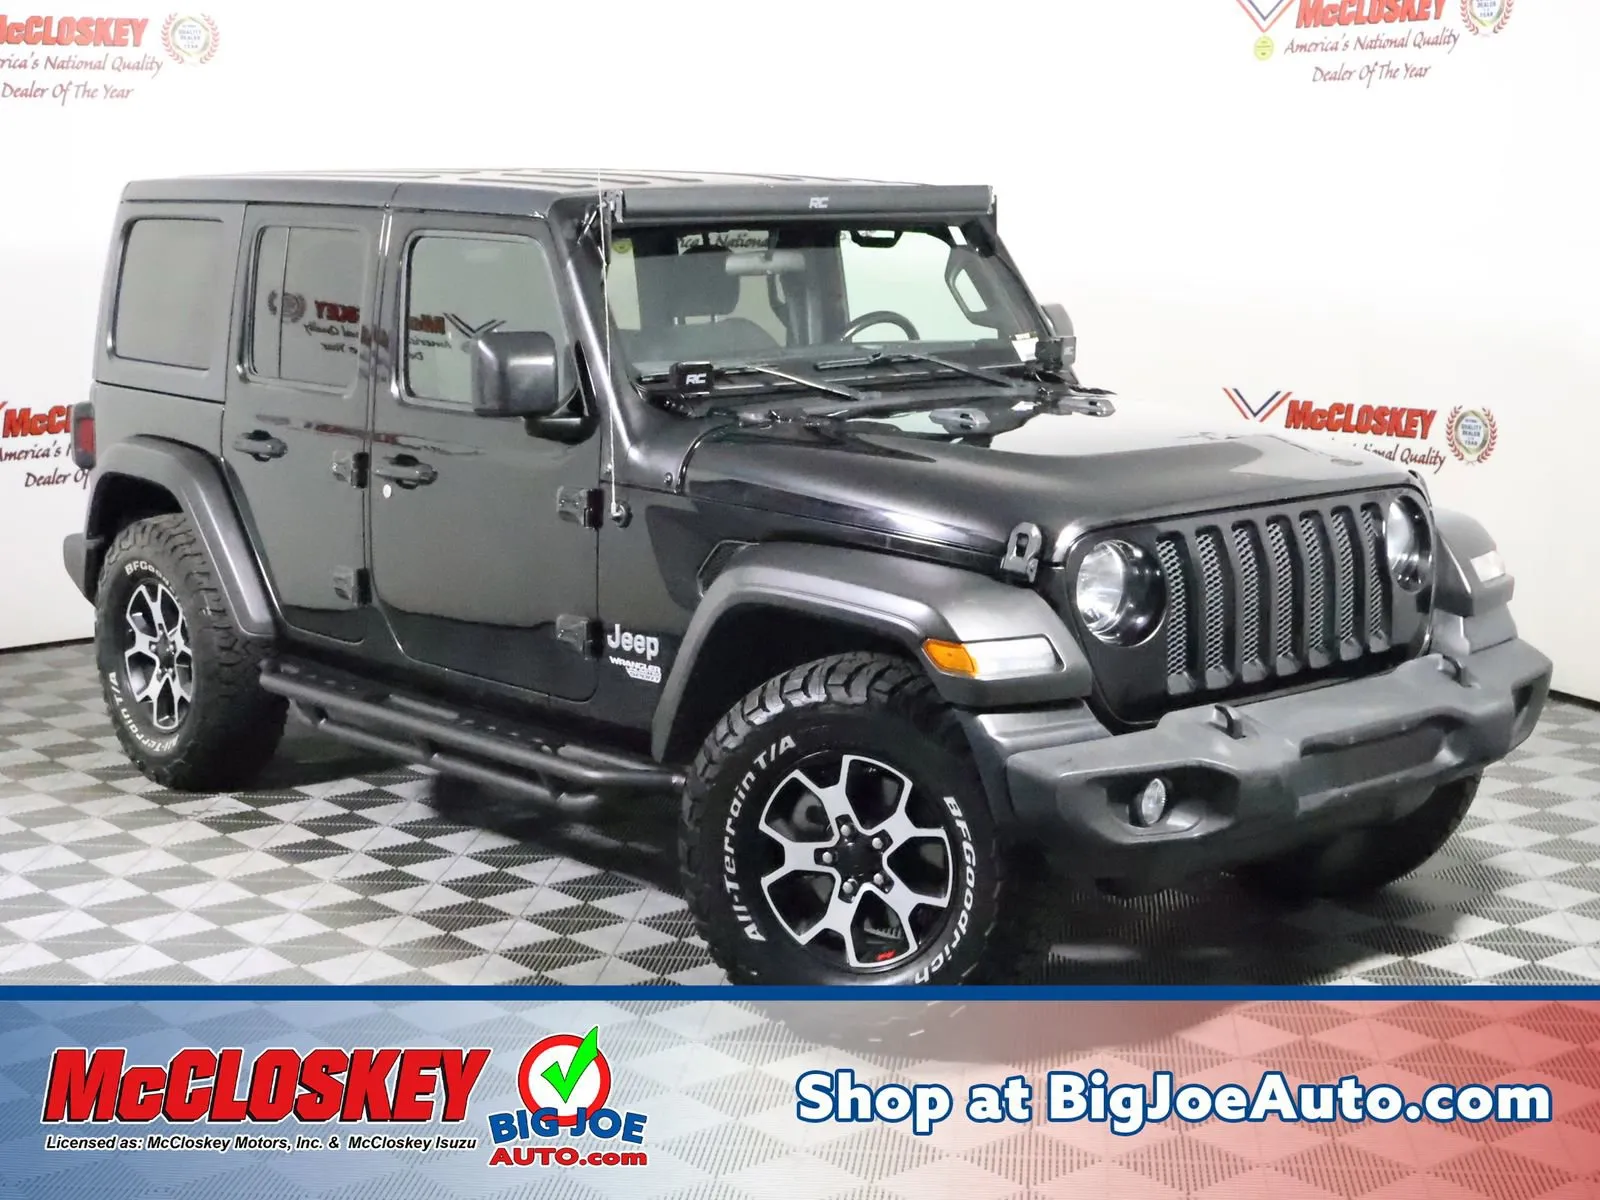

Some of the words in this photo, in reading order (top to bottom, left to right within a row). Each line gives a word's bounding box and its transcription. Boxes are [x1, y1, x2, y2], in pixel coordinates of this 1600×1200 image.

[1295, 0, 1446, 28] McCLOSKEY
[1284, 33, 1349, 54] America's
[1353, 28, 1412, 51] National
[1413, 26, 1460, 54] Quality
[44, 53, 109, 71] National
[111, 53, 163, 79] Quality
[1312, 62, 1356, 82] Dealer
[1358, 61, 1378, 89] Of
[1378, 60, 1400, 80] The
[1403, 62, 1431, 80] Year
[1, 80, 49, 98] Dealer
[52, 80, 73, 107] Of
[74, 81, 99, 99] The
[103, 84, 134, 100] Year
[685, 373, 707, 385] RC
[1285, 400, 1437, 440] McCLOSKEY
[1400, 447, 1446, 474] Quality
[25, 467, 71, 488] Dealer
[607, 623, 660, 661] Jeep
[108, 671, 123, 706] T/A
[722, 770, 767, 942] All-Terrain
[753, 735, 797, 770] T/A
[913, 796, 977, 985] BFGoodrich
